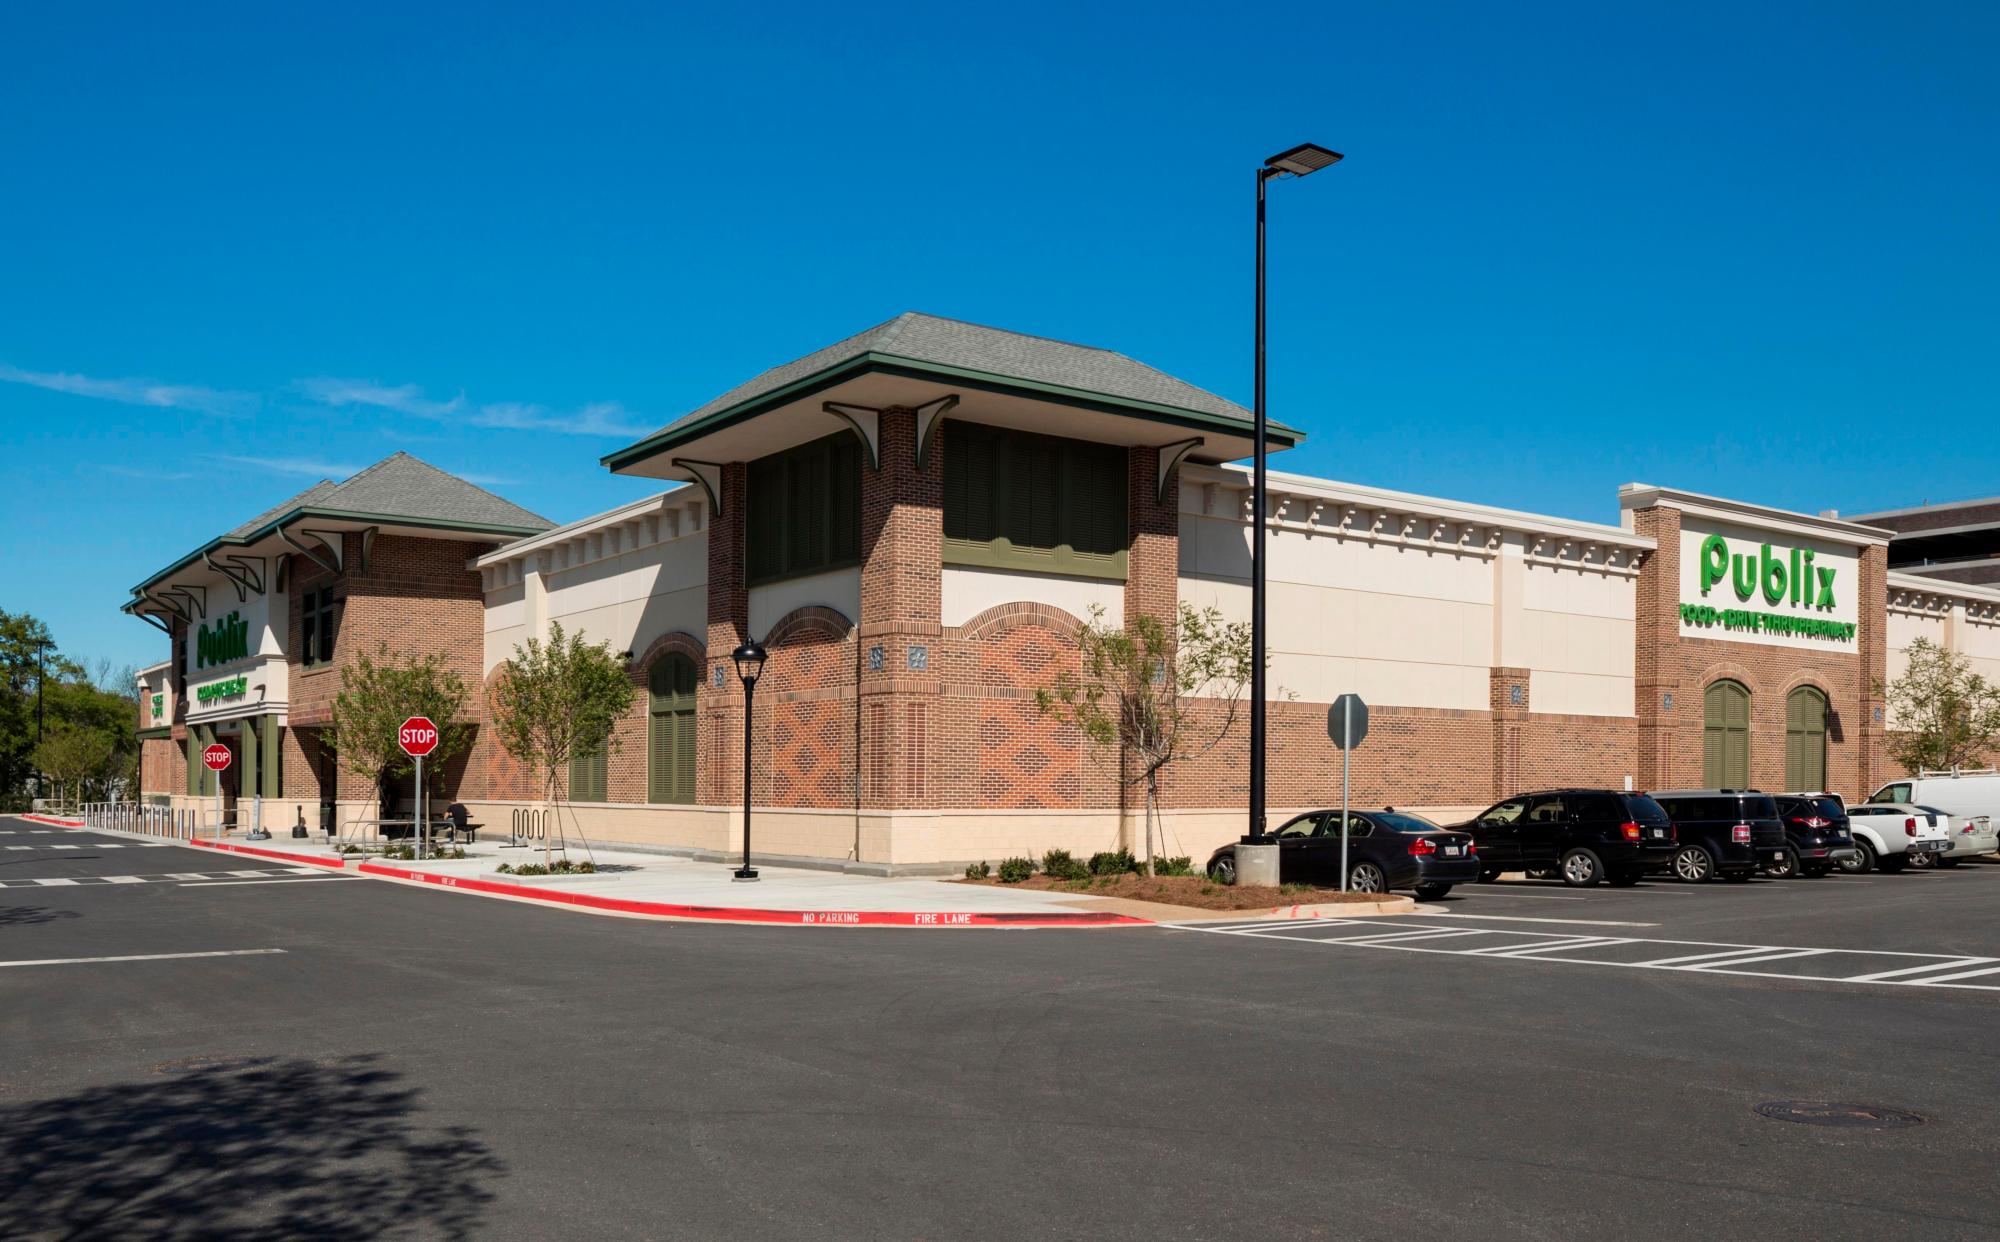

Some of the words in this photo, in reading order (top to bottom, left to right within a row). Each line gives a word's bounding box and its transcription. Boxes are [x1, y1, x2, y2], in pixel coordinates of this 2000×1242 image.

[1700, 534, 1837, 608] Publix
[1797, 617, 1856, 638] PHARMACY
[197, 611, 249, 669] Publix
[402, 729, 435, 744] STOP
[205, 752, 229, 763] STOP
[802, 913, 814, 923] NO
[819, 913, 859, 923] PARKING
[915, 914, 938, 924] FIRE
[944, 914, 971, 924] LANE
